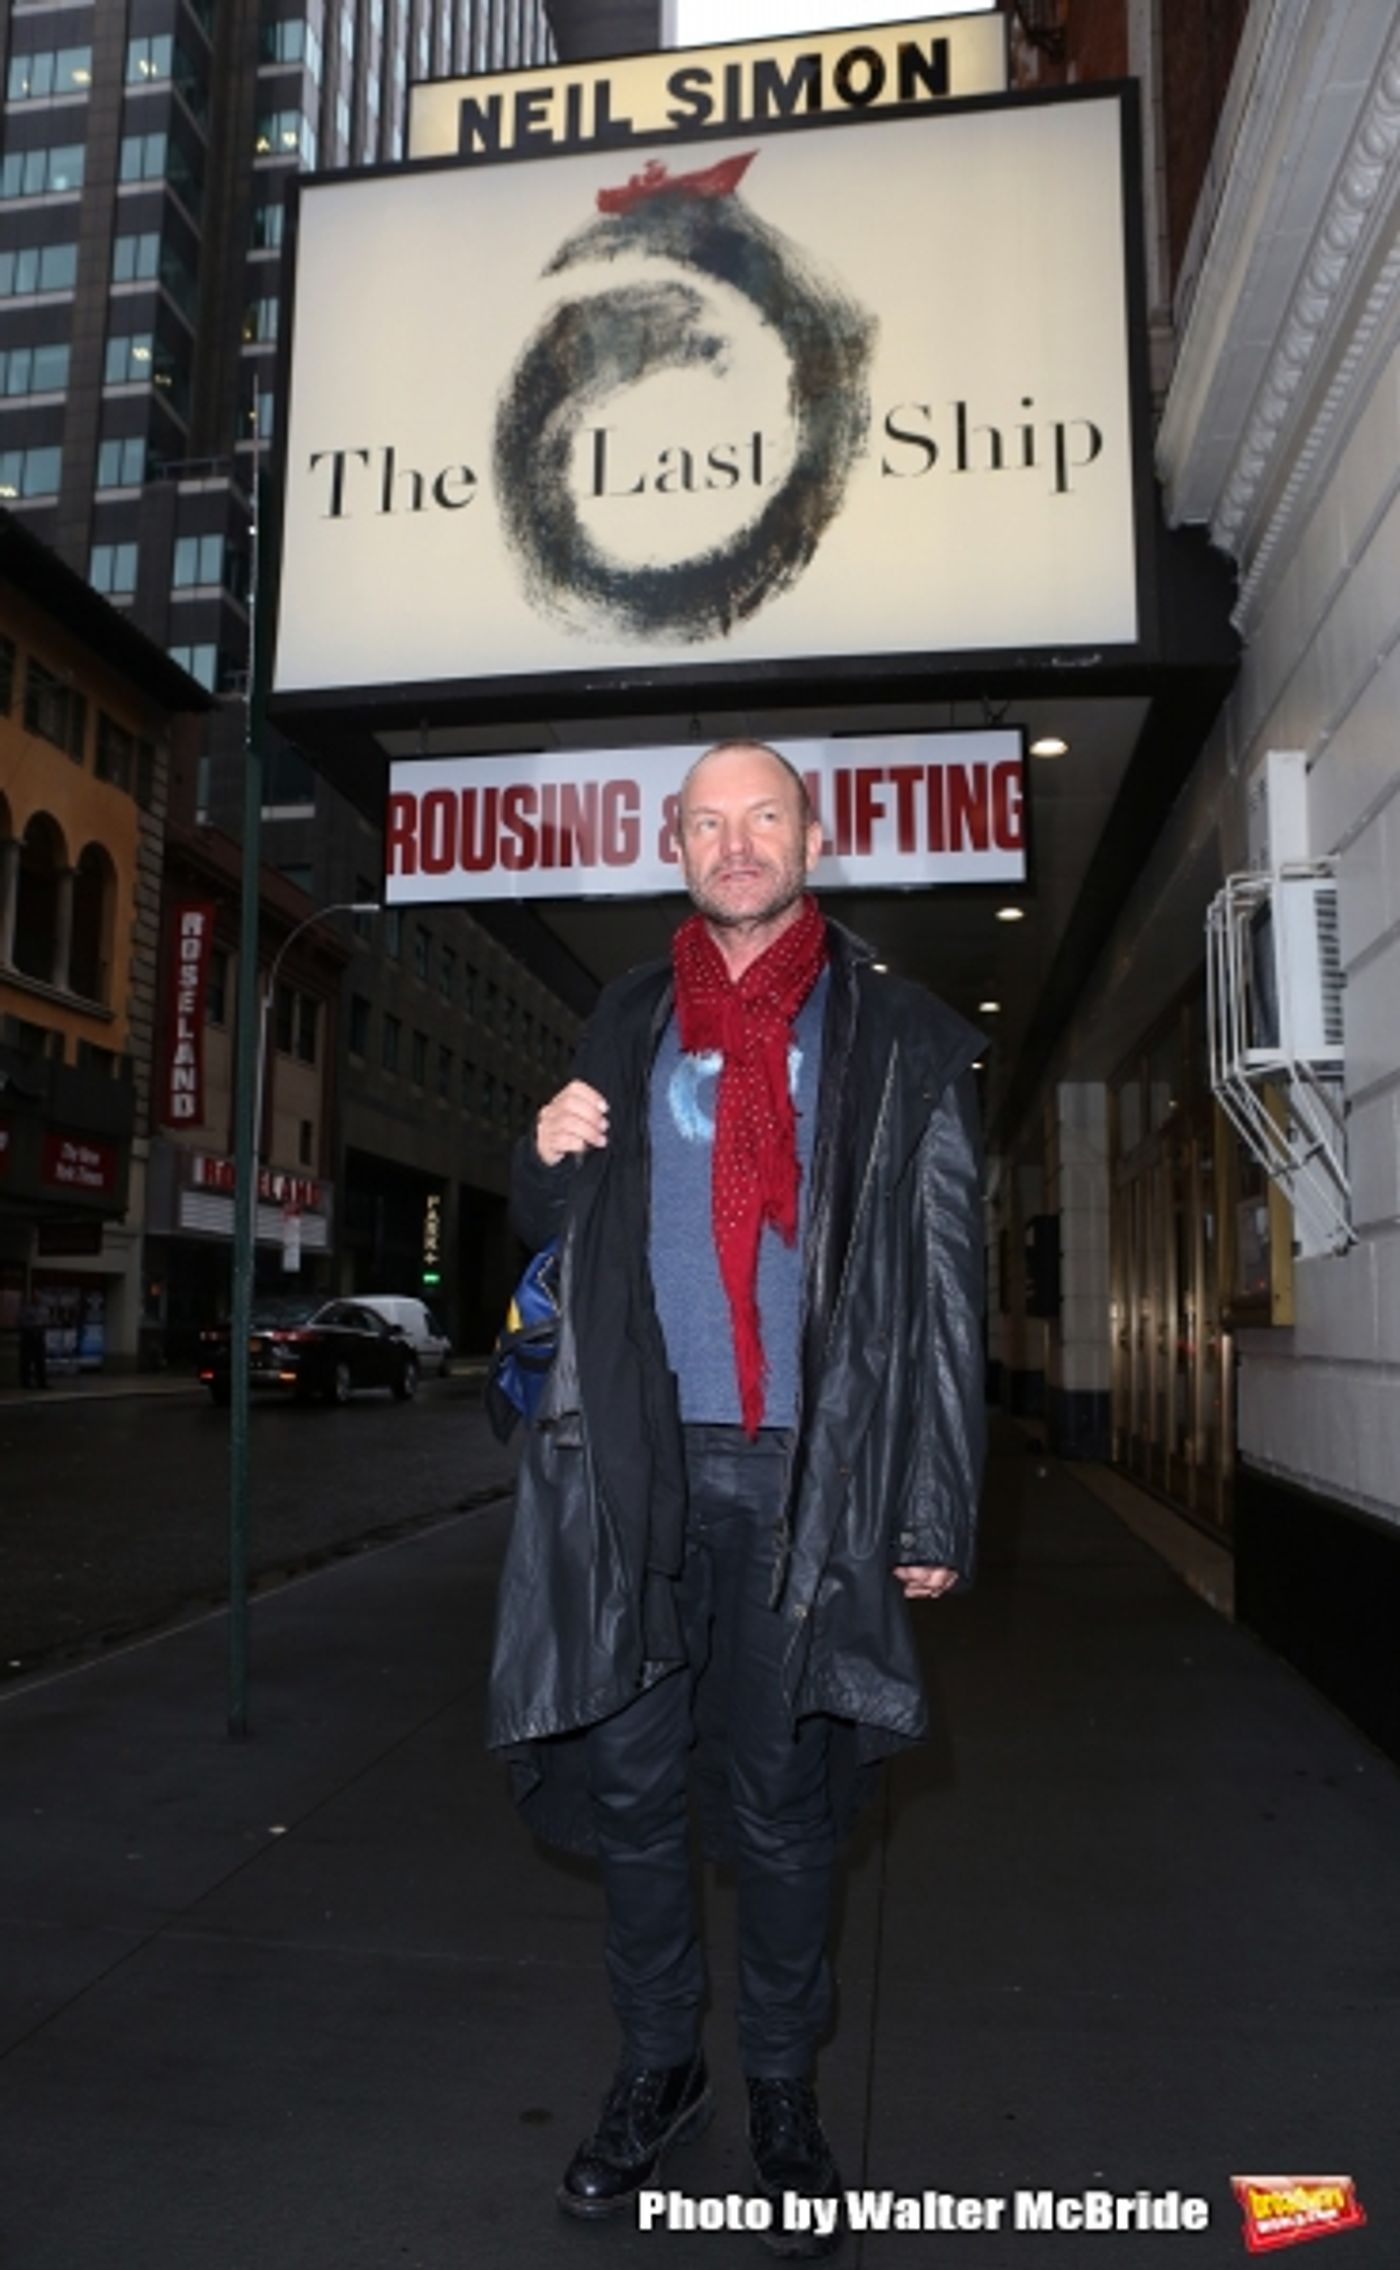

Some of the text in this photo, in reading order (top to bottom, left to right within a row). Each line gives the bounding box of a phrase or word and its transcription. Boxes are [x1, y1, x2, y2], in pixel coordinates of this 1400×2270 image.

[457, 37, 950, 154] NEIL SIMON
[308, 397, 1104, 519] The Last Ship
[385, 779, 640, 876] ROUSING
[803, 761, 1024, 856] LIFTING
[171, 911, 205, 1119] ROSELAND
